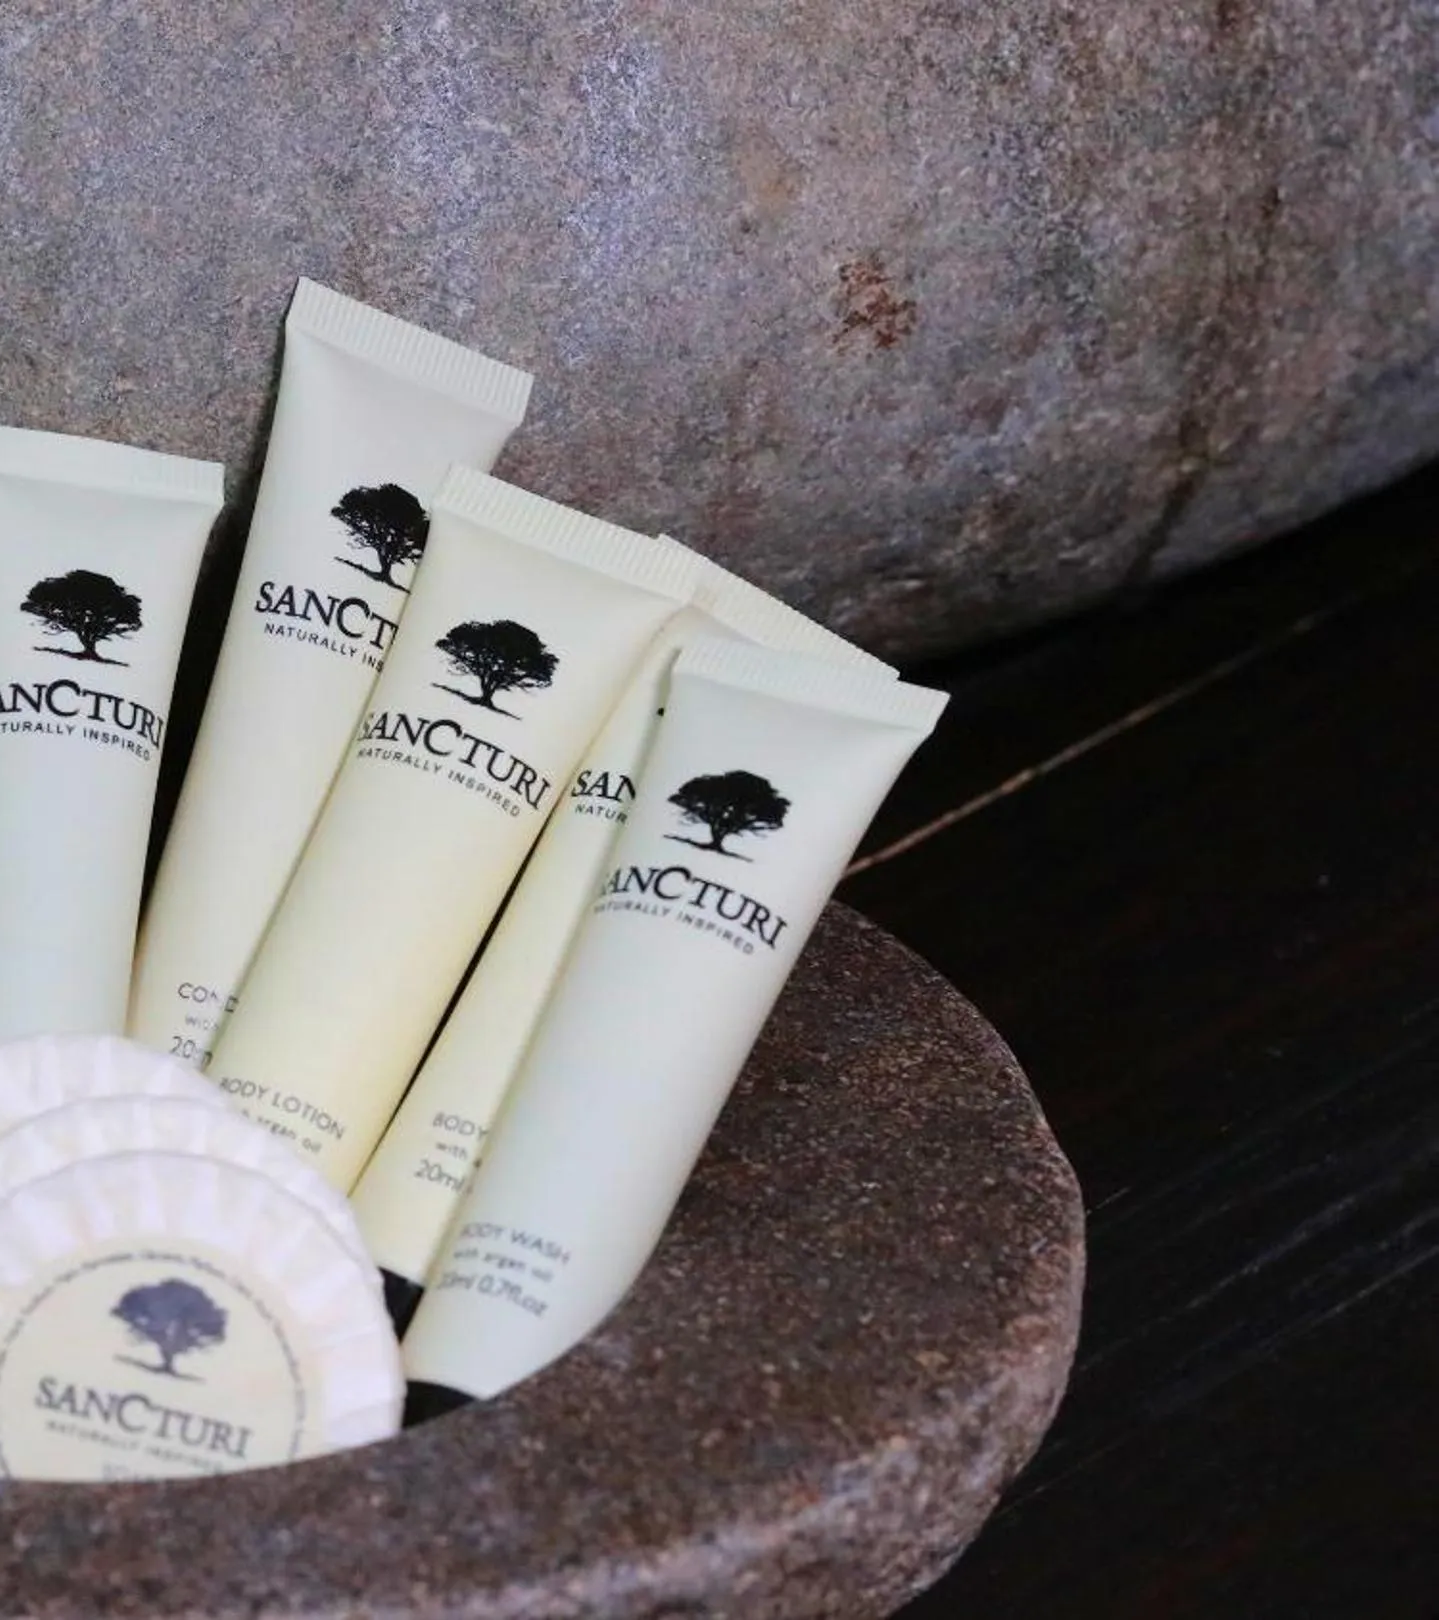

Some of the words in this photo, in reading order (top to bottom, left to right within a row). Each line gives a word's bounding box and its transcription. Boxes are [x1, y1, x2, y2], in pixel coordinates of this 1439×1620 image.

[254, 581, 400, 649] SANCT
[264, 623, 358, 657] NATURALLY
[83, 727, 151, 761] INSPIRED
[358, 747, 442, 774] NATURALLY
[448, 769, 521, 818] INSPIRED
[575, 803, 629, 824] NATUR
[601, 866, 787, 950] ANCTURI
[677, 911, 755, 955] INSPIRED
[271, 1091, 346, 1140] LOTION
[511, 1229, 571, 1265] WASH
[35, 1376, 254, 1461] SANCTURI
